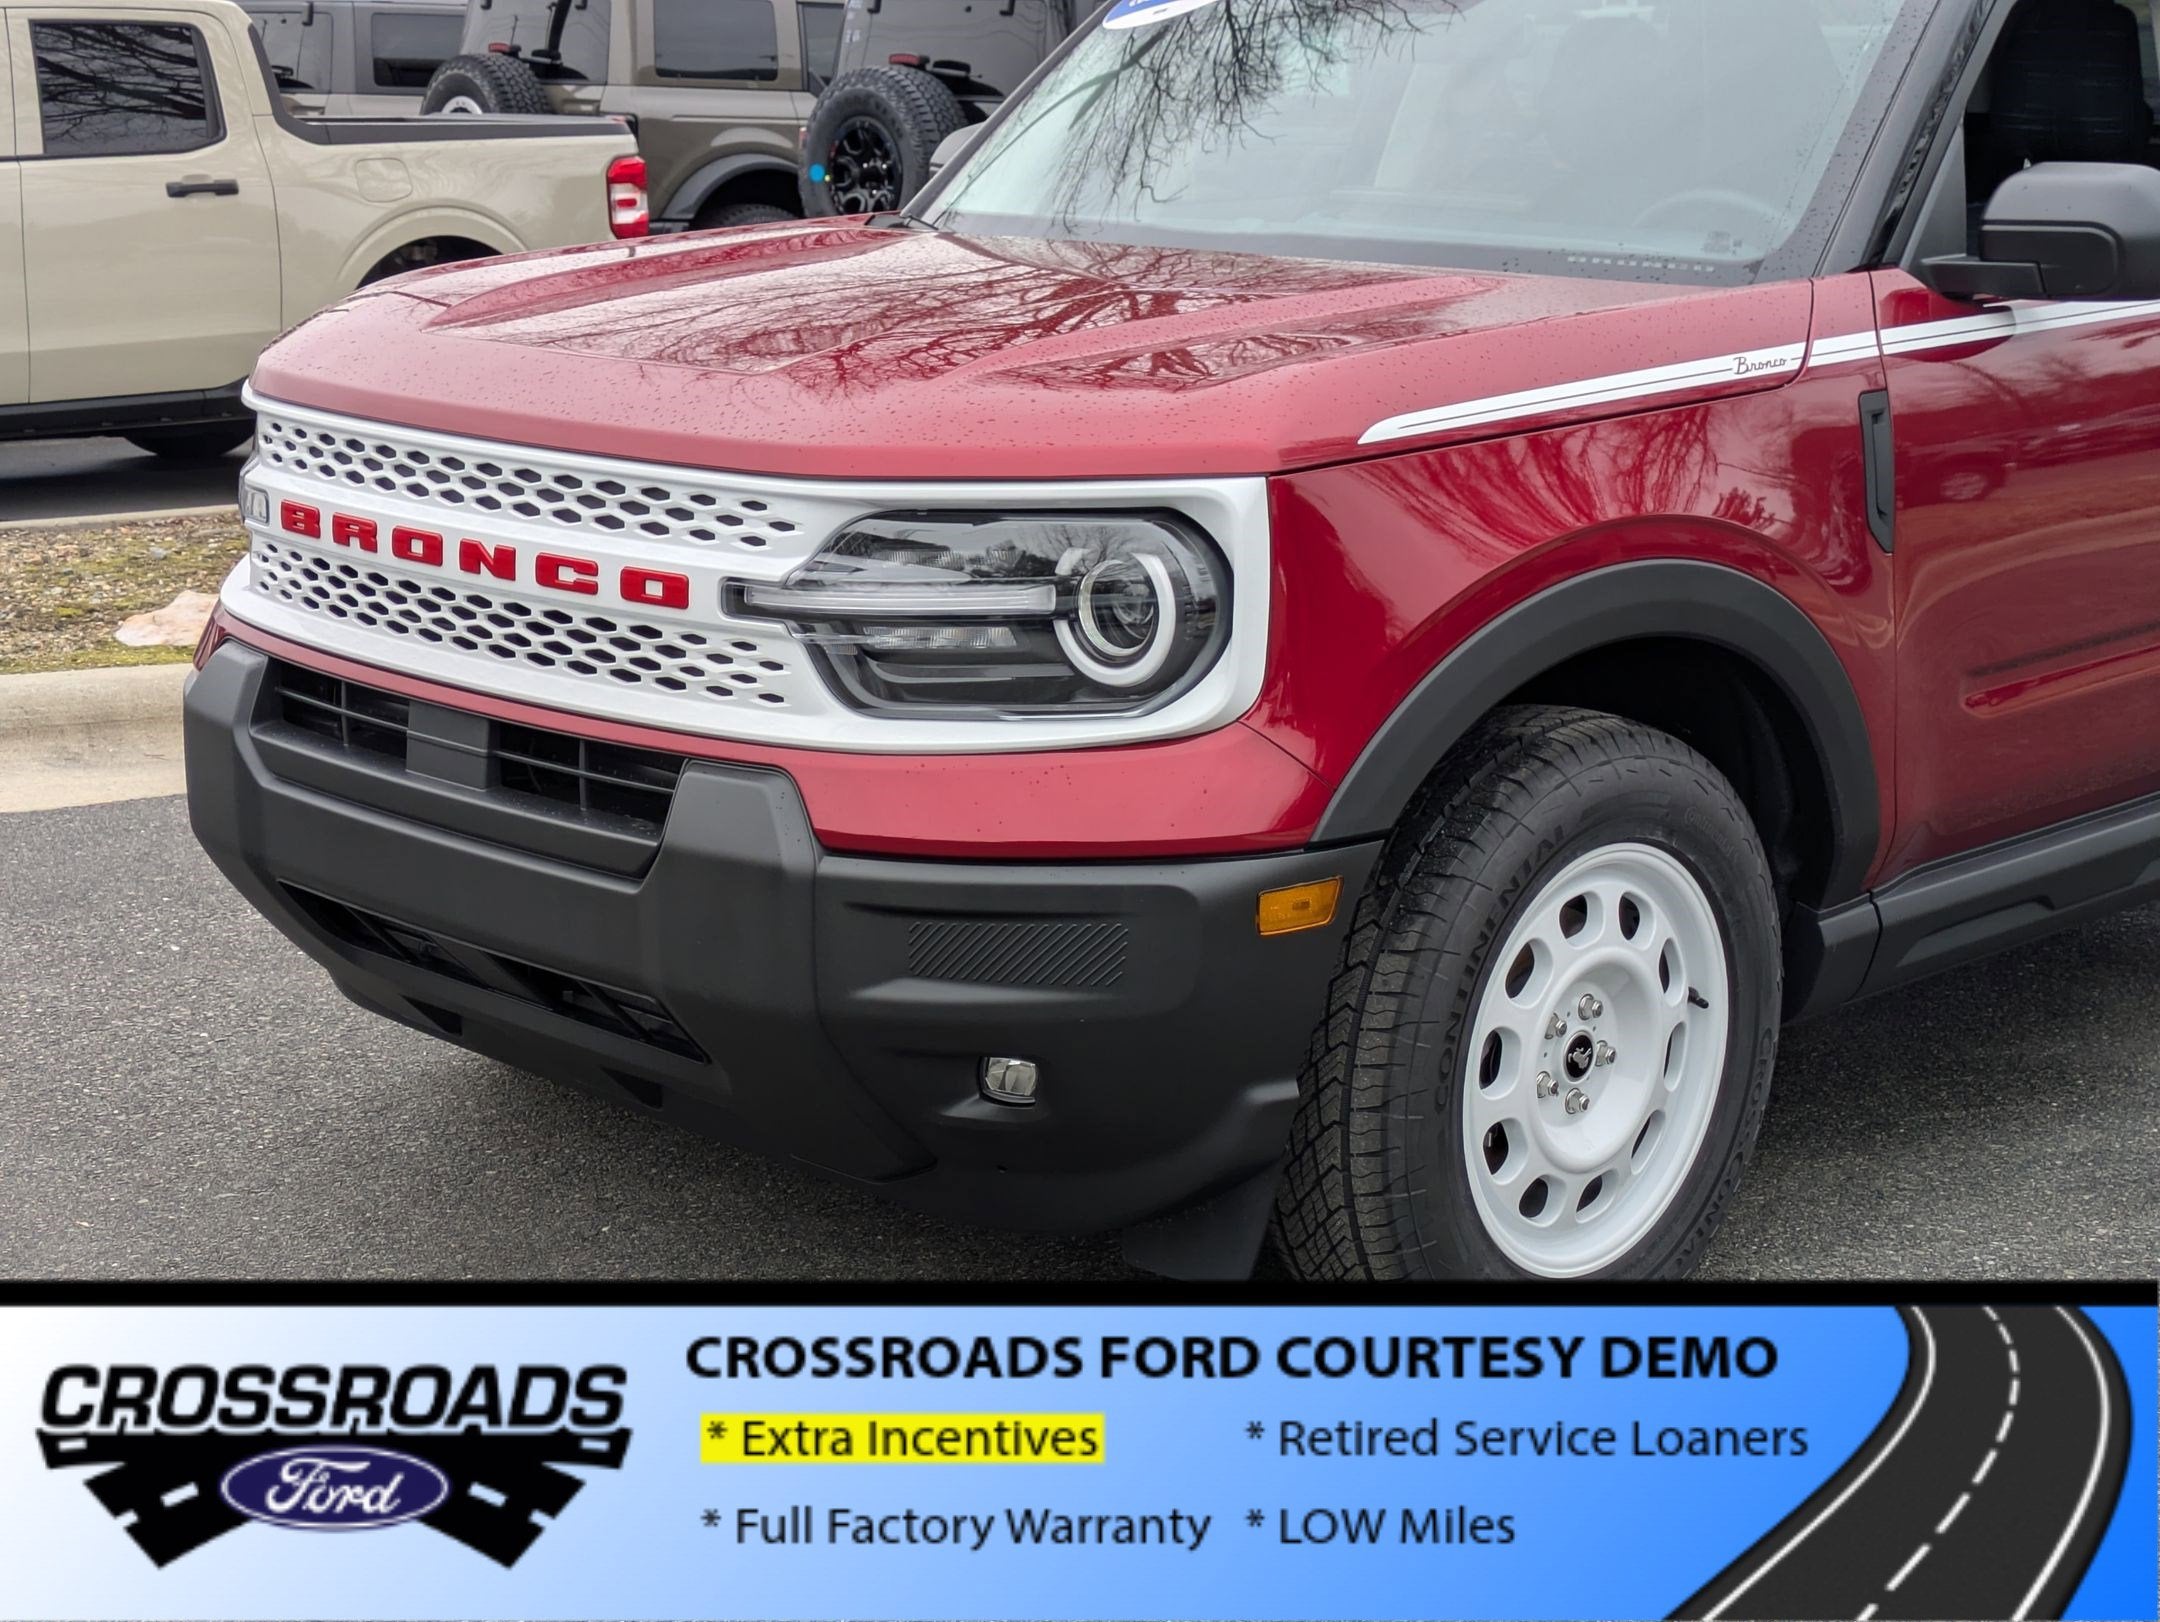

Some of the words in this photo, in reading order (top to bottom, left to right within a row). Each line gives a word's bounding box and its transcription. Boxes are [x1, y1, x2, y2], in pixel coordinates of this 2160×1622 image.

[1733, 356, 1787, 375] Bronco
[280, 498, 691, 610] BRONCO
[1434, 823, 1568, 1115] CONTINENTAL
